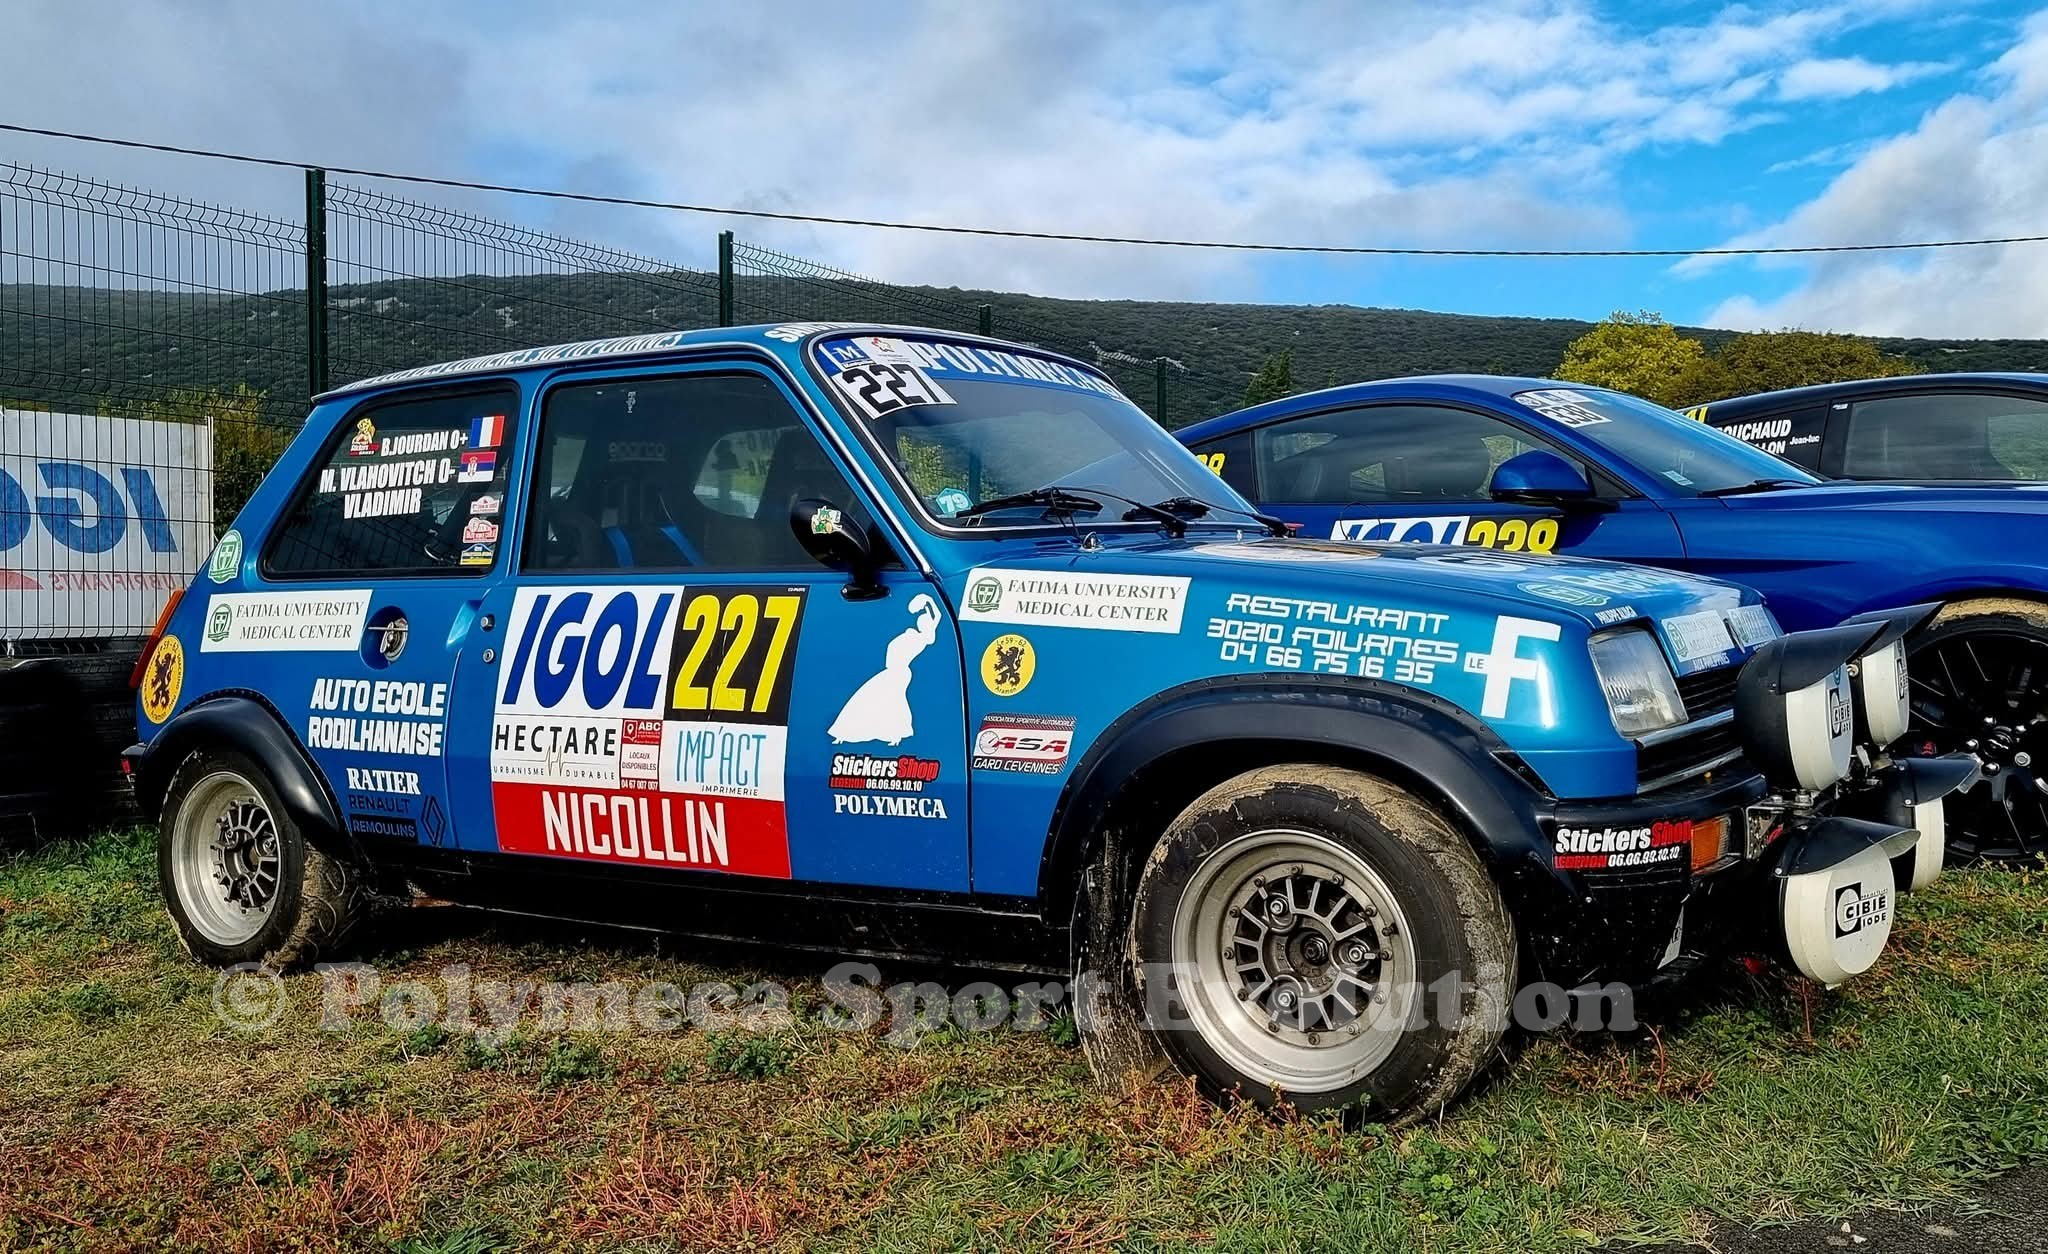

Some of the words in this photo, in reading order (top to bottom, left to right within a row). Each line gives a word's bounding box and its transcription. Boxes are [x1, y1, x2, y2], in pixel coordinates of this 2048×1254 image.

[905, 342, 1107, 392] POLYMECA
[842, 363, 941, 414] 227
[381, 431, 449, 456] B.JOURDAN
[320, 469, 336, 494] M.
[340, 459, 436, 492] VLAHOVITCH
[344, 488, 422, 519] VLADIMIR
[939, 493, 968, 512] 79
[1008, 579, 1069, 596] FATIMA
[1074, 583, 1182, 600] UNIVERSITY
[236, 604, 281, 619] FATIMA
[284, 601, 365, 618] UNIVERSITY
[1015, 600, 1094, 618] MEDICAL
[1097, 604, 1169, 622] CENTER
[1227, 593, 1450, 634] RESTAURANT
[240, 625, 297, 640] MEDICAL
[299, 624, 352, 639] CENTER
[1207, 618, 1283, 644] 30210
[1291, 627, 1459, 664] FOURNES
[502, 591, 675, 710] IGOL
[672, 594, 801, 713] 227
[1220, 641, 1257, 664] 04
[1265, 646, 1302, 668] 66
[1313, 651, 1348, 673] 75
[1359, 655, 1385, 678] 16
[1394, 660, 1435, 683] 35
[1464, 615, 1561, 719] F
[1468, 656, 1484, 669] LE
[310, 678, 371, 712] AUTO
[371, 681, 447, 716] ECOLE
[638, 721, 661, 731] ABC
[1016, 717, 1041, 725] SPORTIVE
[308, 717, 443, 757] RODILHANAISE
[494, 724, 616, 757] HECTARE
[992, 736, 1067, 753] ASA
[622, 761, 656, 770] DISPONIBLES
[629, 751, 650, 759] LOCAUX
[493, 766, 544, 777] URBANISME
[566, 769, 615, 780] DURABLE
[973, 758, 1002, 770] GARD
[1004, 760, 1060, 774] CEVENNES
[346, 767, 421, 794] RATIER
[701, 785, 759, 797] IMPRIMERIE
[866, 778, 923, 791] 06.06.99.10.10
[349, 795, 411, 814] RENAULT
[834, 794, 948, 819] POLYMECA
[352, 817, 416, 837] REMOULINS
[542, 791, 729, 866] NICOLLIN
[1608, 846, 1680, 867] 06.06.99.10.10
[1862, 912, 1887, 928] IODE
